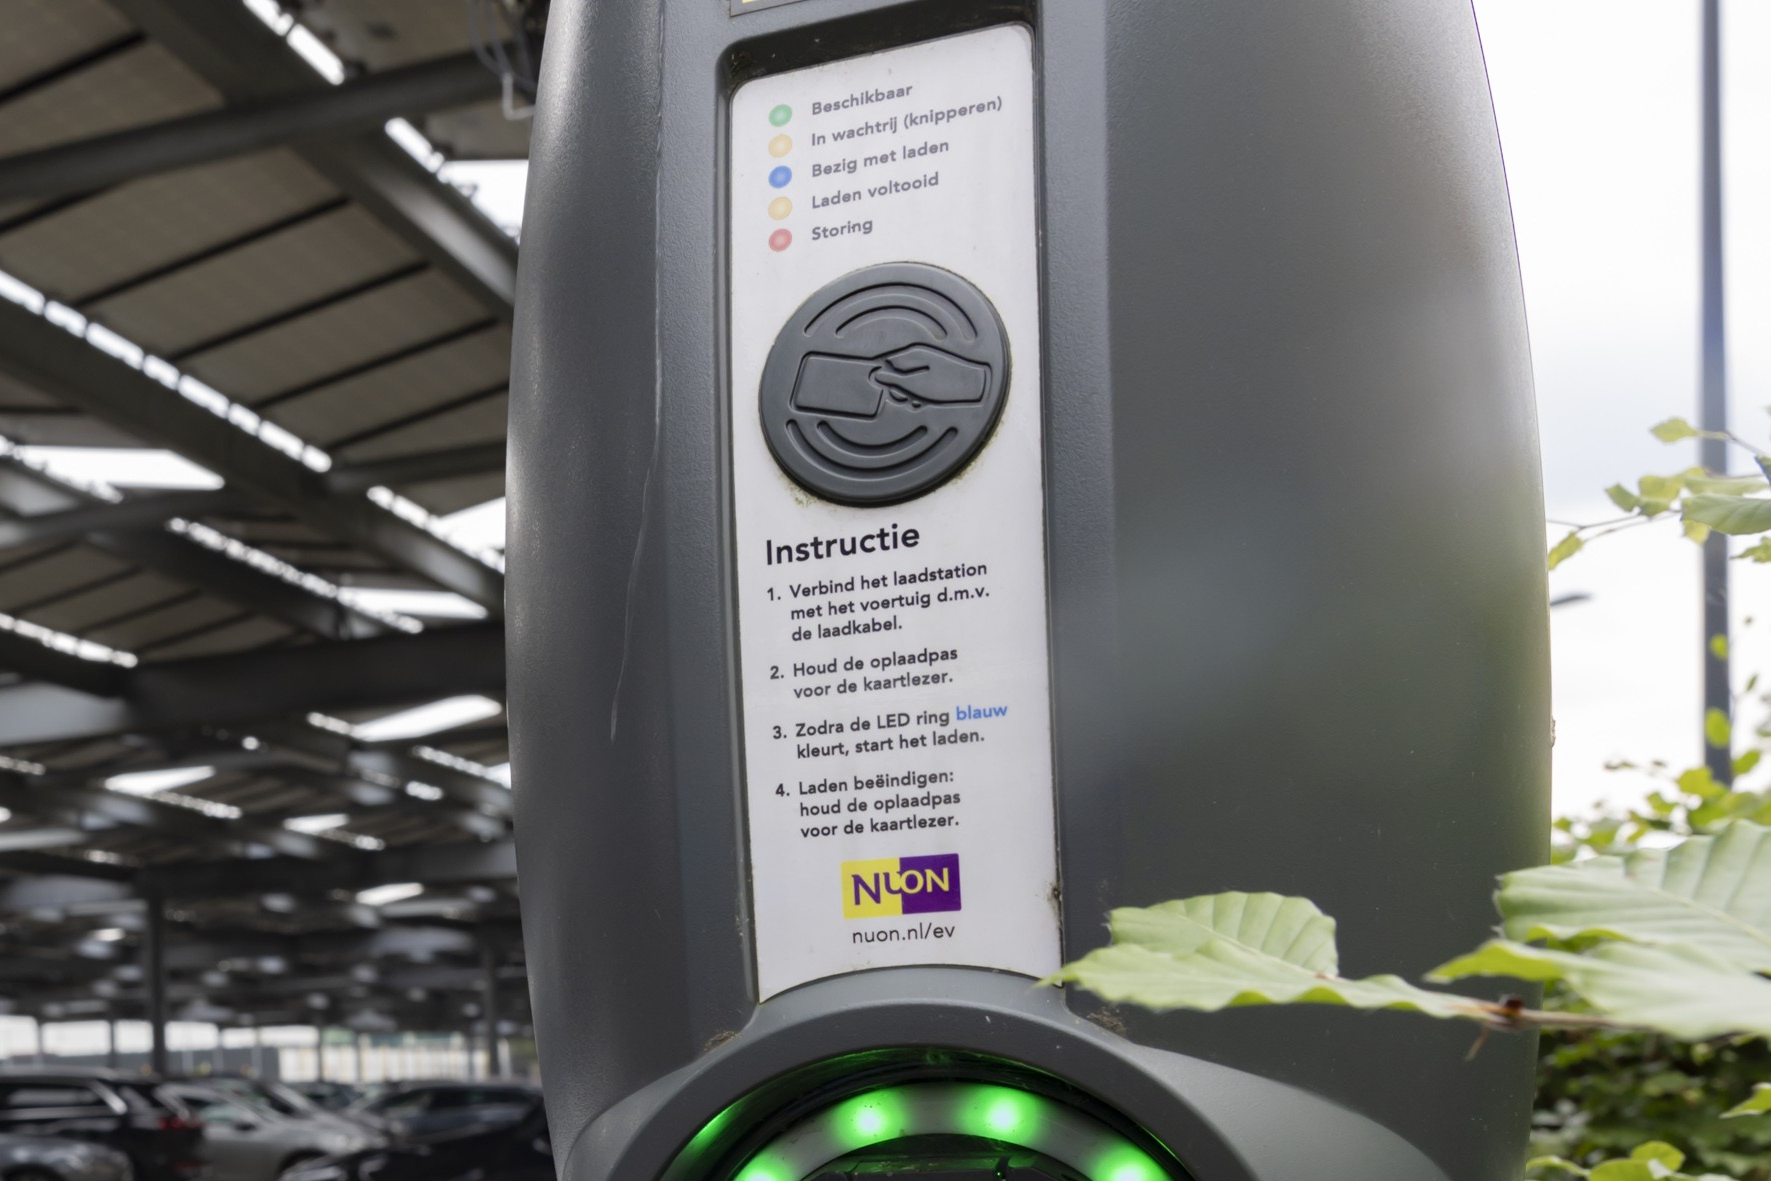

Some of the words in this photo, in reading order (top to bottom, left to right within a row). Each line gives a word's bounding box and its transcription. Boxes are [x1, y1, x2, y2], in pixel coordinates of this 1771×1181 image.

[812, 86, 913, 115] Beschikbaar
[812, 133, 826, 146] In
[832, 116, 897, 142] wachtrij
[904, 96, 1002, 129] (knipperen)
[812, 158, 857, 177] Bezig
[864, 150, 896, 167] met
[903, 141, 949, 160] laden
[812, 190, 862, 209] Laden
[868, 171, 939, 198] voltooid
[812, 220, 873, 241] Storing
[766, 523, 920, 565] Instructie
[767, 587, 781, 601] 1.
[789, 576, 855, 598] Verbind
[861, 575, 888, 590] het
[894, 563, 987, 586] laadstation
[791, 605, 823, 620] met
[828, 601, 855, 616] het
[860, 591, 931, 611] voertuig
[937, 587, 989, 602] d.m.v.
[792, 626, 812, 642] de
[818, 615, 902, 639] laadkabel.
[770, 665, 784, 680] 2.
[793, 658, 837, 677] Houd
[843, 656, 864, 671] de
[870, 648, 958, 671] oplaadpas
[793, 685, 831, 699] voor
[837, 678, 857, 694] de
[863, 672, 953, 691] kaartlezer.
[773, 725, 787, 740] 3.
[795, 720, 844, 737] Zodra
[850, 716, 871, 732] de
[877, 713, 910, 729] LED
[916, 710, 950, 727] ring
[956, 705, 1008, 721] blauw
[797, 742, 849, 759] kleurt,
[855, 738, 894, 753] start
[899, 734, 927, 749] het
[933, 729, 984, 746] laden.
[775, 783, 790, 797] 4.
[799, 778, 848, 795] Laden
[854, 771, 953, 790] beëindigen:
[800, 799, 841, 817] houd
[847, 797, 868, 813] de
[874, 791, 961, 813] oplaadpas
[800, 825, 838, 838] voor
[843, 819, 864, 835] de
[870, 814, 959, 832] kaartlezer.
[852, 867, 949, 905] NUON
[853, 922, 955, 944] nuon.nl/ev
